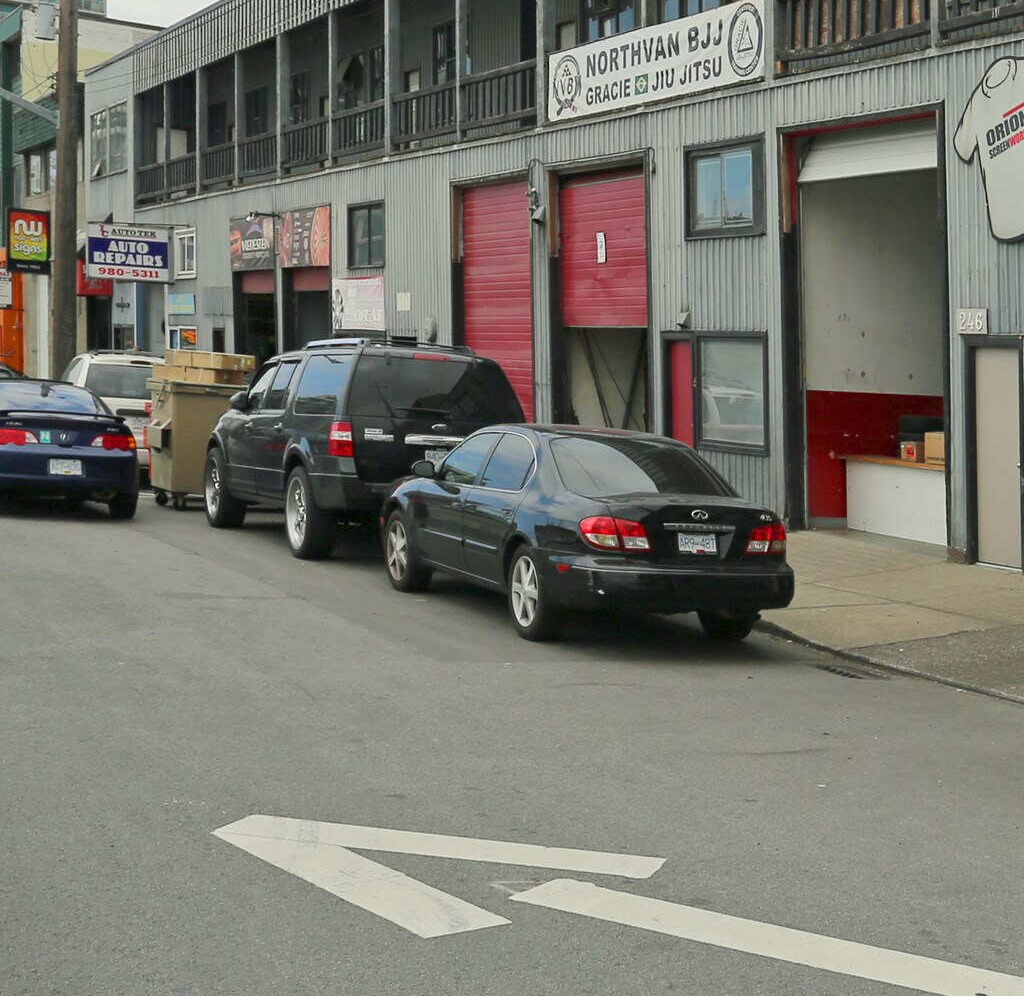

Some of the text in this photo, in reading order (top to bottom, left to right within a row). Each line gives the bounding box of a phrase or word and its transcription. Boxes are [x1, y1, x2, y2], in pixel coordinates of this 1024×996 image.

[586, 30, 681, 79] NORTHVAN
[687, 18, 724, 53] BJJ
[585, 78, 632, 106] GRACIE
[651, 67, 675, 92] JIU
[679, 56, 723, 86] JITSU
[111, 228, 136, 236] AUTO
[14, 241, 42, 256] signs
[108, 240, 149, 254] AUTO
[93, 251, 163, 267] REPAIRS
[98, 267, 160, 279] 980-5311
[959, 312, 983, 331] 246
